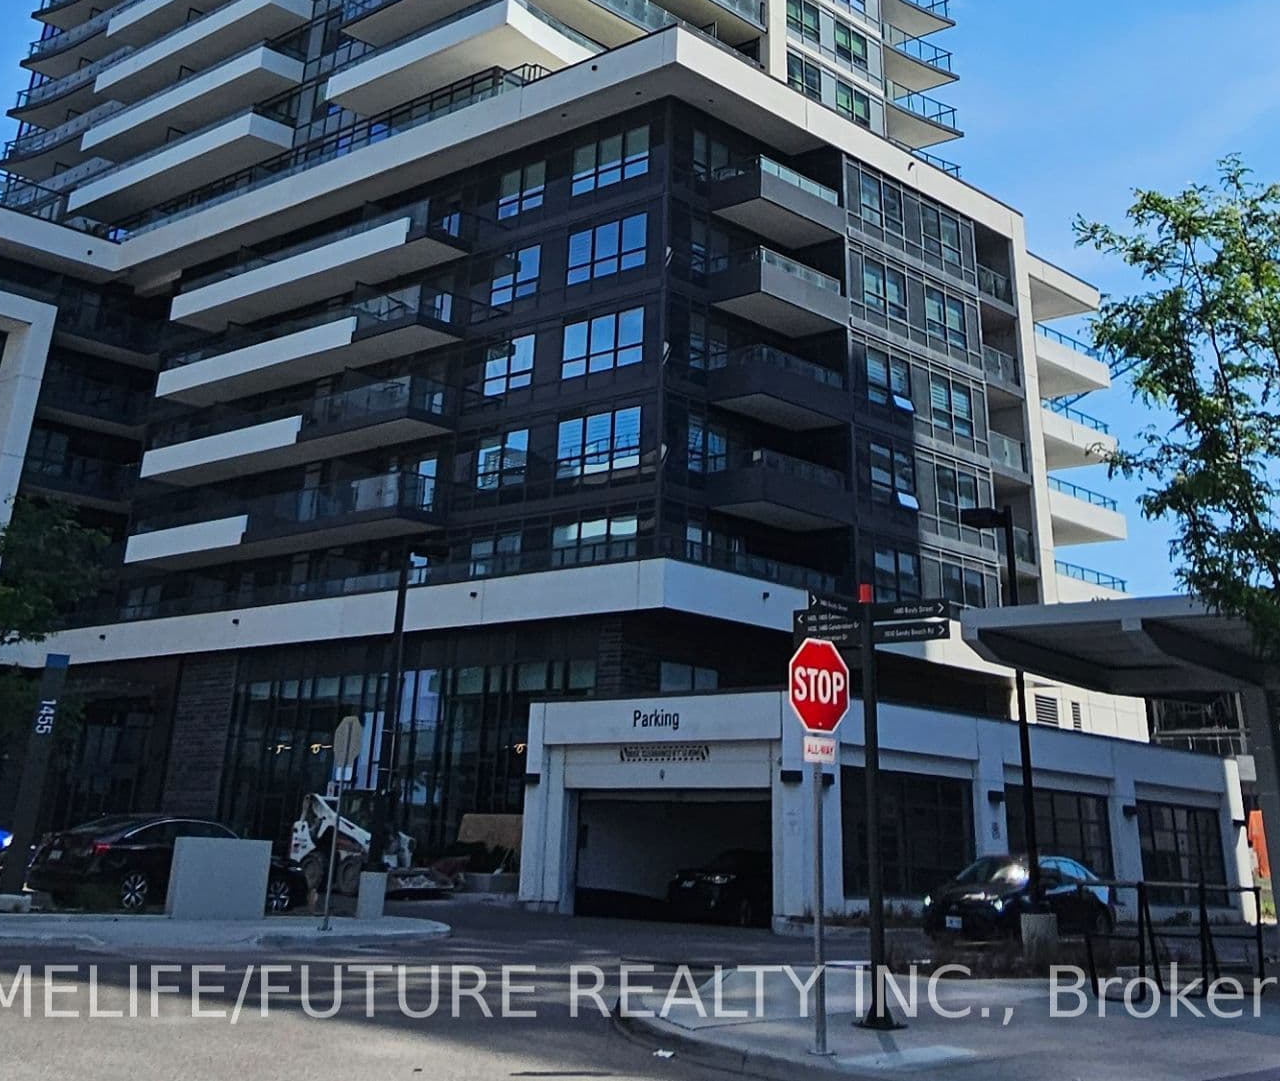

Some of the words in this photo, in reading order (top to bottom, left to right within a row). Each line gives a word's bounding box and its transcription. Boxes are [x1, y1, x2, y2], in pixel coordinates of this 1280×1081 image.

[794, 665, 845, 705] STOP
[35, 699, 57, 734] 1455
[633, 709, 680, 731] Parking
